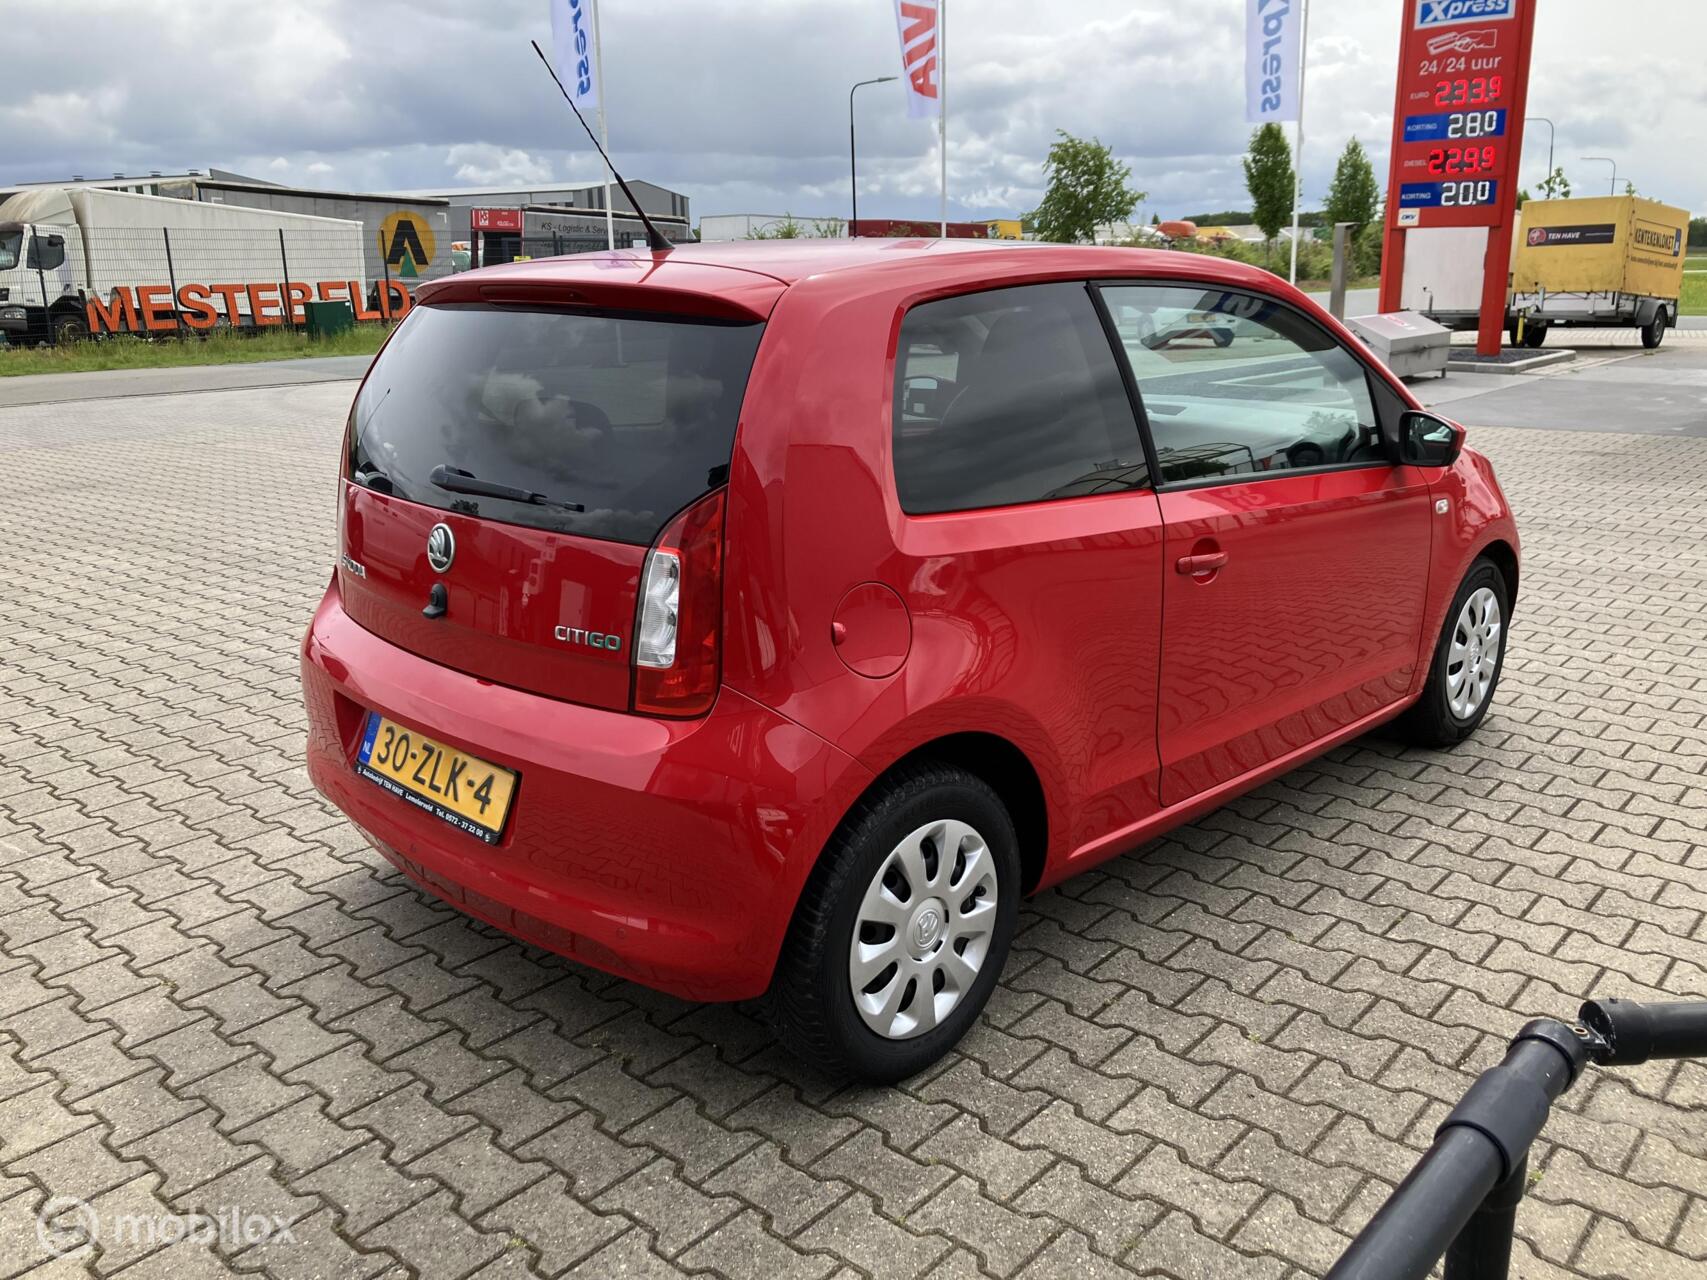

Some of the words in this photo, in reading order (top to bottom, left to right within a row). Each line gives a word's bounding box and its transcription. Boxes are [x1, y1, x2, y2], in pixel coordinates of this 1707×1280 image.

[1419, 57, 1466, 76] 24/24
[1471, 56, 1502, 71] uur
[1447, 110, 1497, 138] 28.0
[1401, 191, 1432, 201] KORTING
[1440, 181, 1490, 206] 20.0
[1548, 232, 1561, 240] TEN
[1561, 231, 1581, 239] HAVE
[554, 625, 622, 651] CITIGO
[362, 740, 371, 755] NL
[377, 725, 496, 815] 30-ZLK-4
